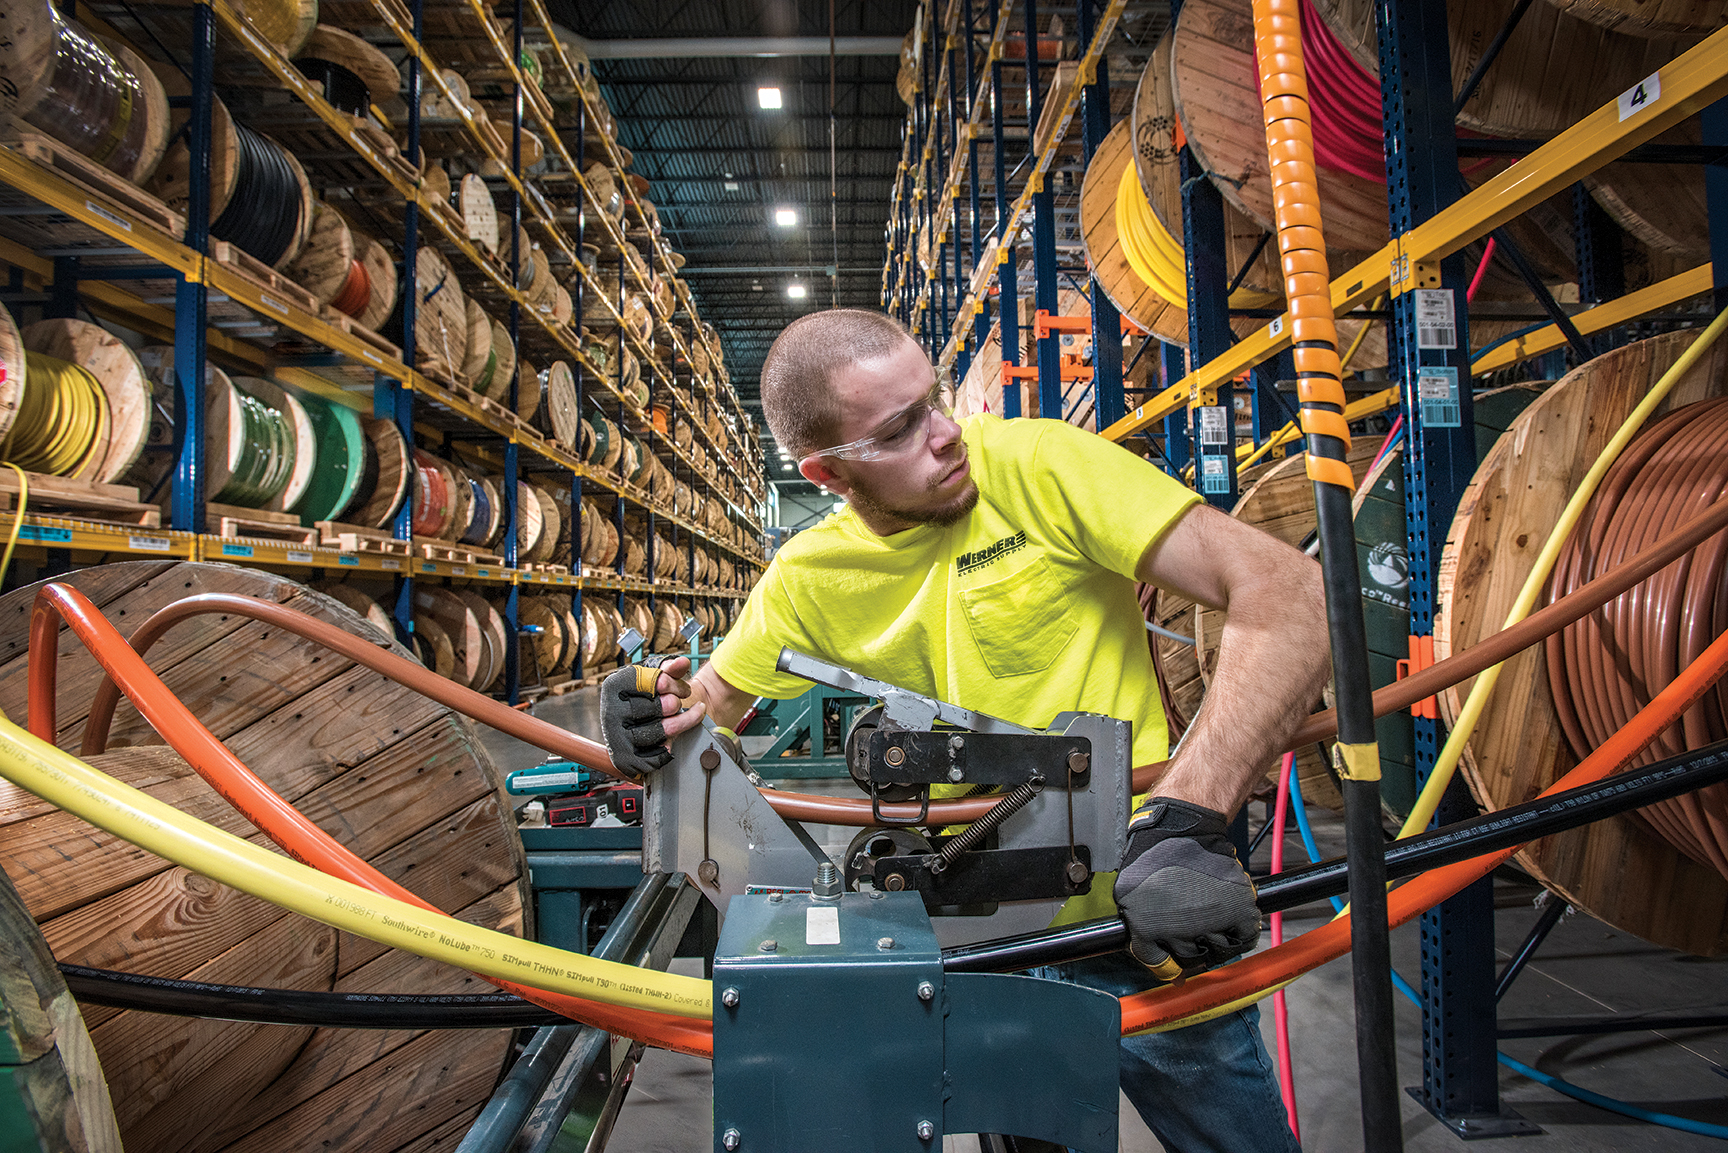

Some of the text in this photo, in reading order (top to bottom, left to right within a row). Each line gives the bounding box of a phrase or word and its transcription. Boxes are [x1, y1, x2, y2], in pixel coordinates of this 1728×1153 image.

[1630, 83, 1648, 108] 4
[1273, 320, 1279, 332] 6
[956, 535, 1016, 570] WERNER
[957, 544, 1027, 577] ELECTRIC SUPPLY
[501, 953, 532, 968] SIMpull
[566, 971, 595, 985] SIMpull
[673, 993, 704, 1007] Covered
